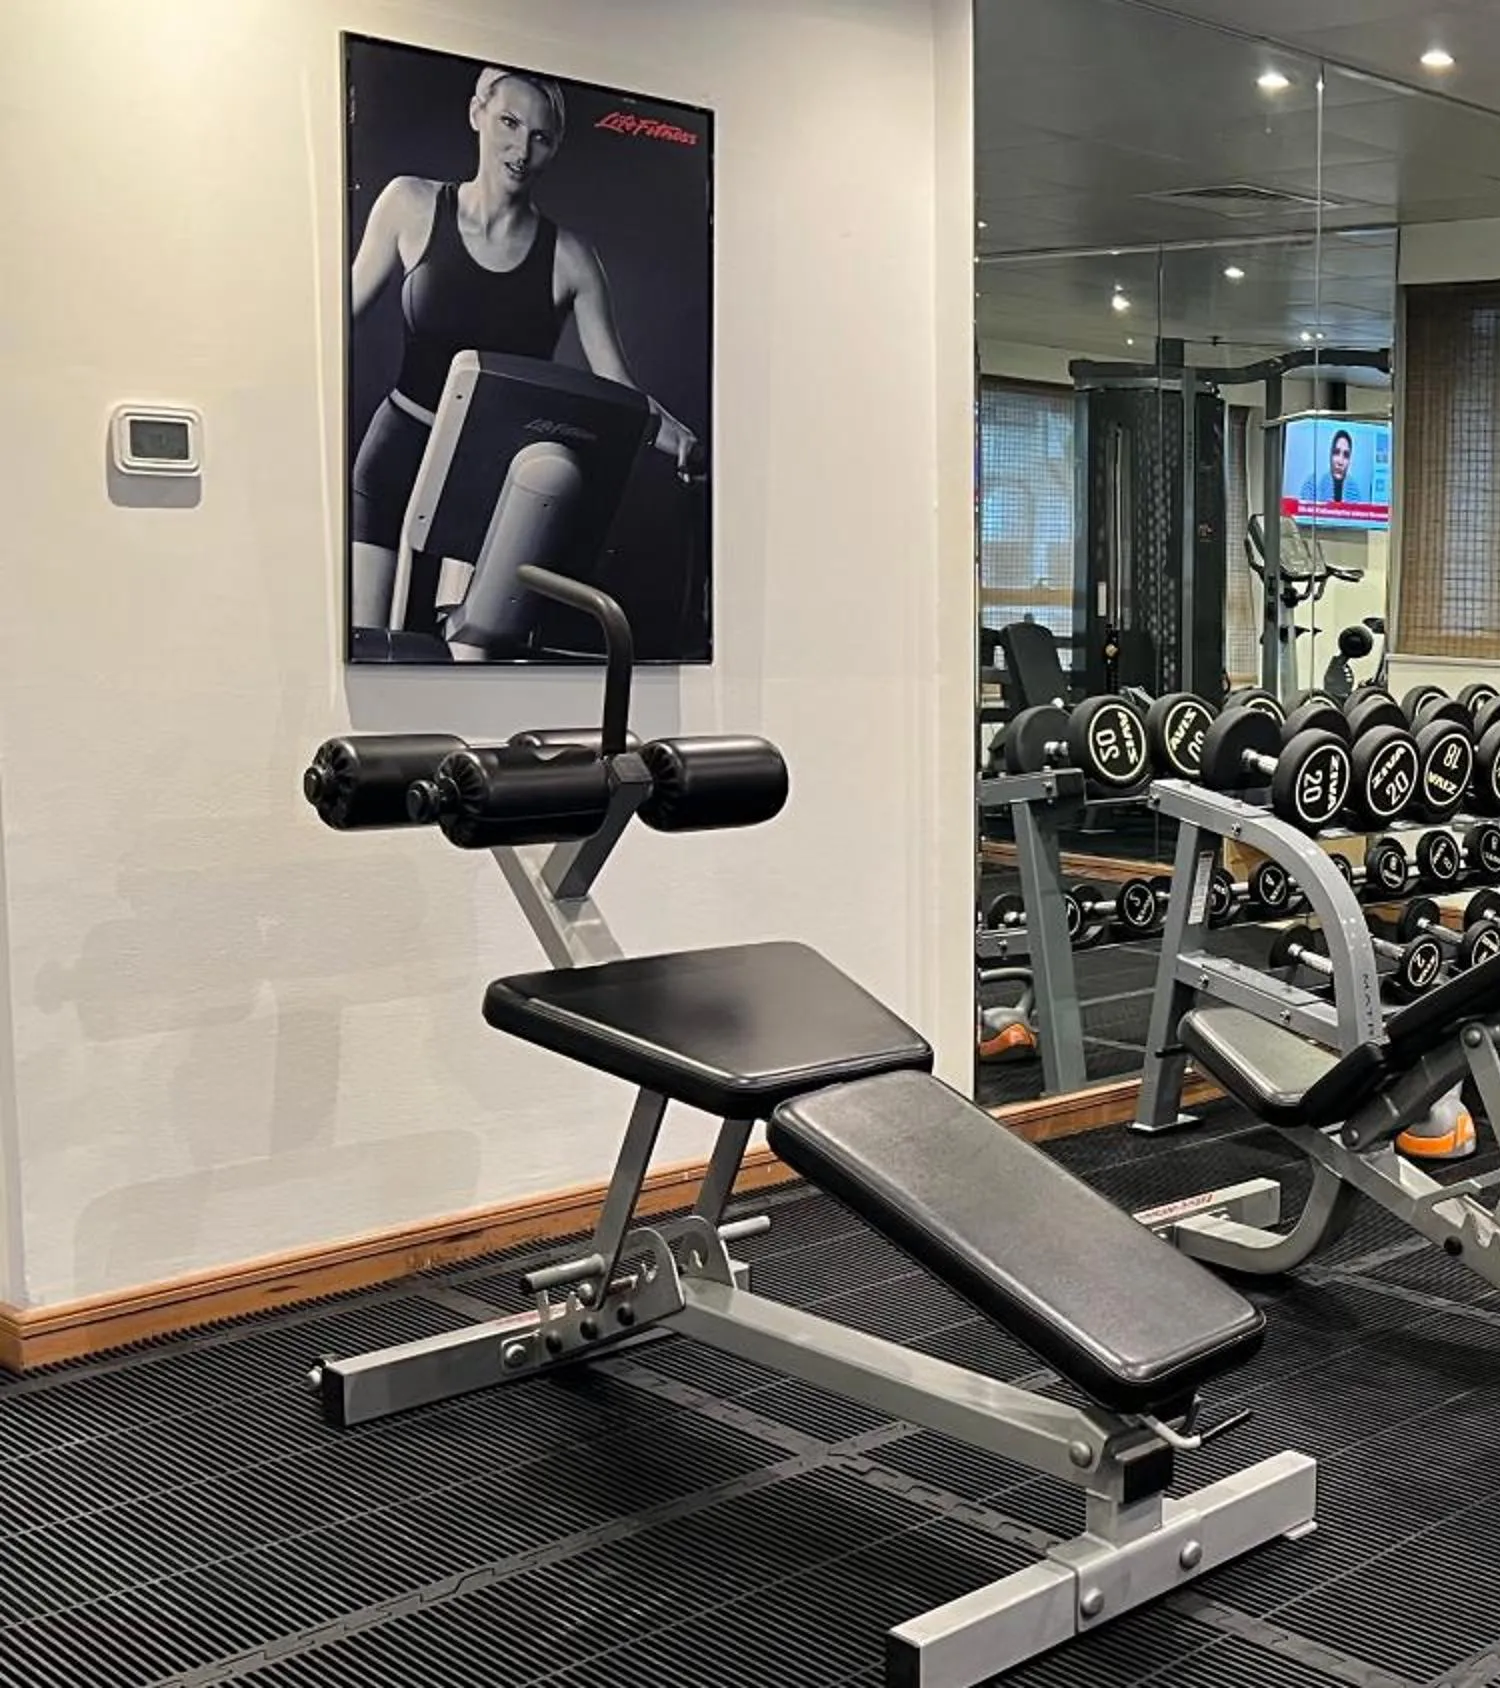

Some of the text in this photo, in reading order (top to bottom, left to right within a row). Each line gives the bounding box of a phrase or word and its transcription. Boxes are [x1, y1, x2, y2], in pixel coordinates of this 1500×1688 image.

[1371, 746, 1406, 789] ZIVA
[1443, 742, 1463, 770] 18
[1303, 769, 1323, 803] 20
[1327, 754, 1340, 811] ZIVA
[1385, 770, 1409, 806] 20
[1428, 770, 1458, 795] ZIVA
